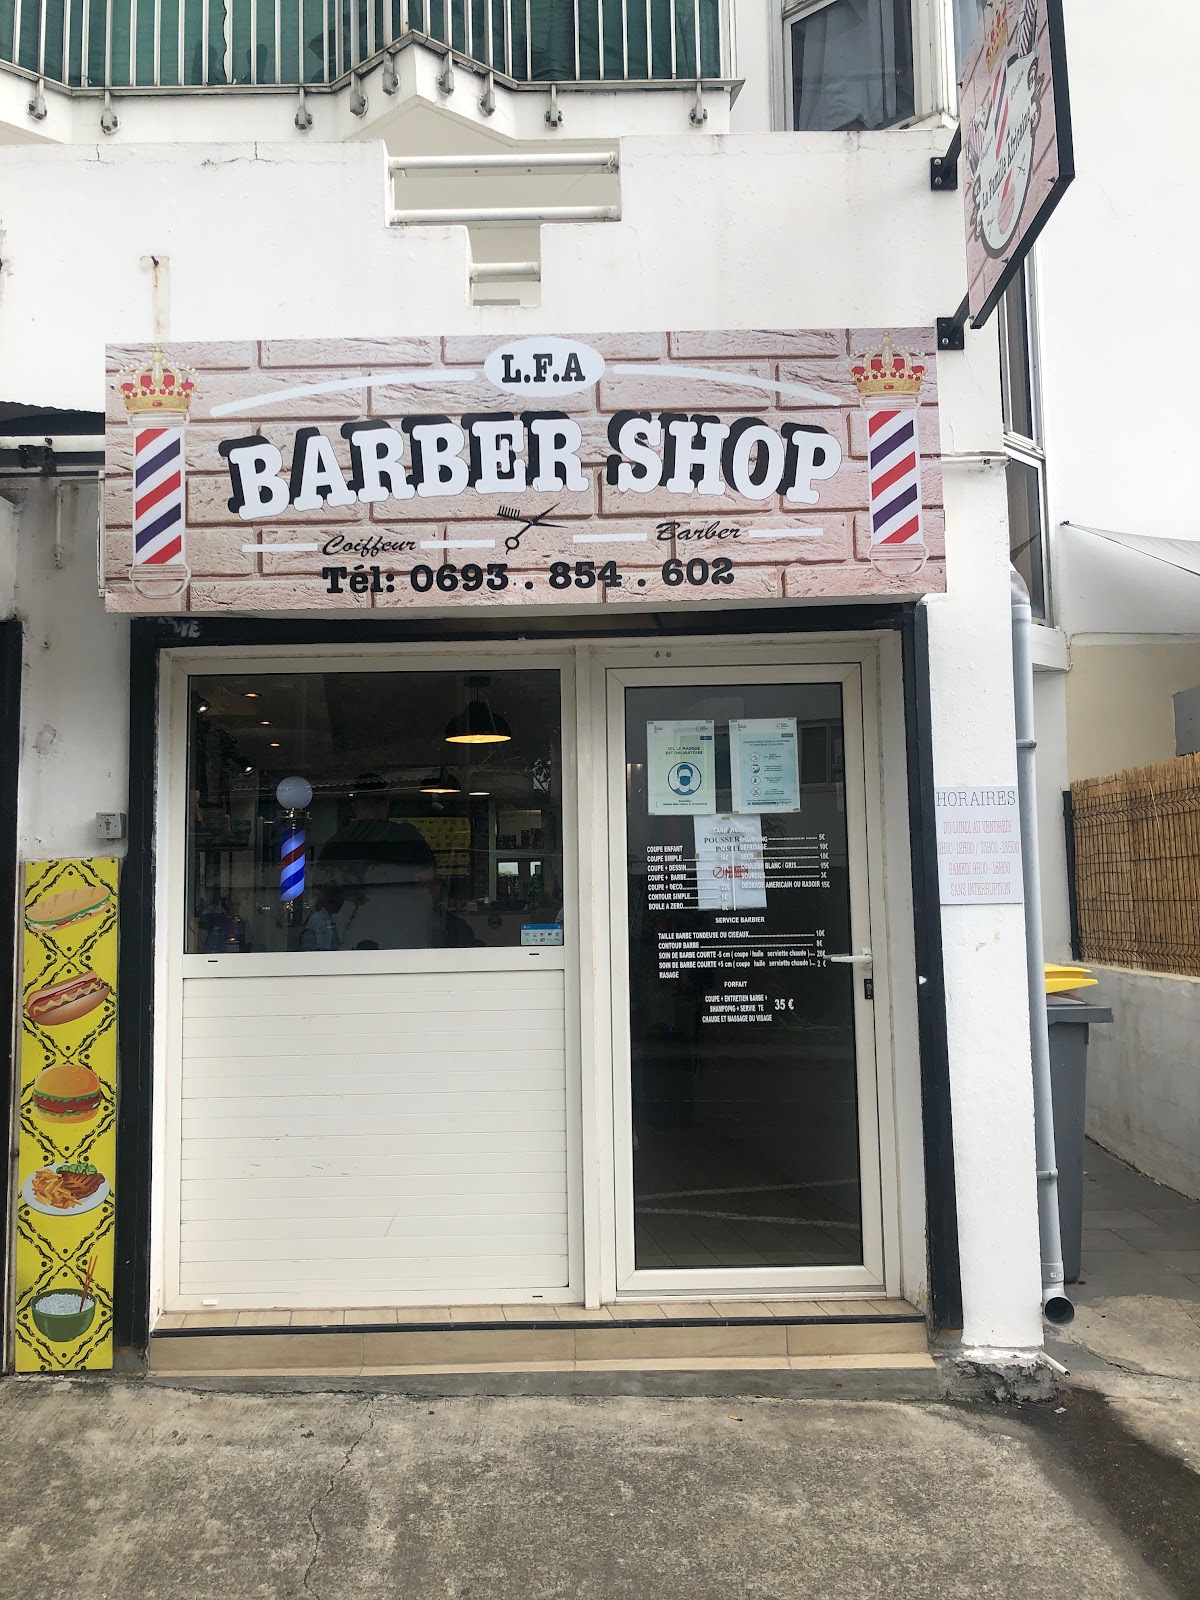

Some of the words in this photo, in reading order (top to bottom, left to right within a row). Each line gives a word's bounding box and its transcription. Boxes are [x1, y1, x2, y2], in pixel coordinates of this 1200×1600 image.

[502, 353, 586, 383] L.F.A
[218, 411, 589, 520] BARBER
[606, 410, 842, 505] SHOP
[656, 521, 741, 541] Barber
[322, 535, 416, 557] Coiffeur
[322, 565, 395, 593] Tél:
[410, 563, 509, 592] 0693
[549, 561, 622, 589] 854
[661, 557, 735, 586] 602
[936, 791, 1016, 806] HORAIRES
[775, 999, 785, 1010] 35
[788, 999, 794, 1010] €
